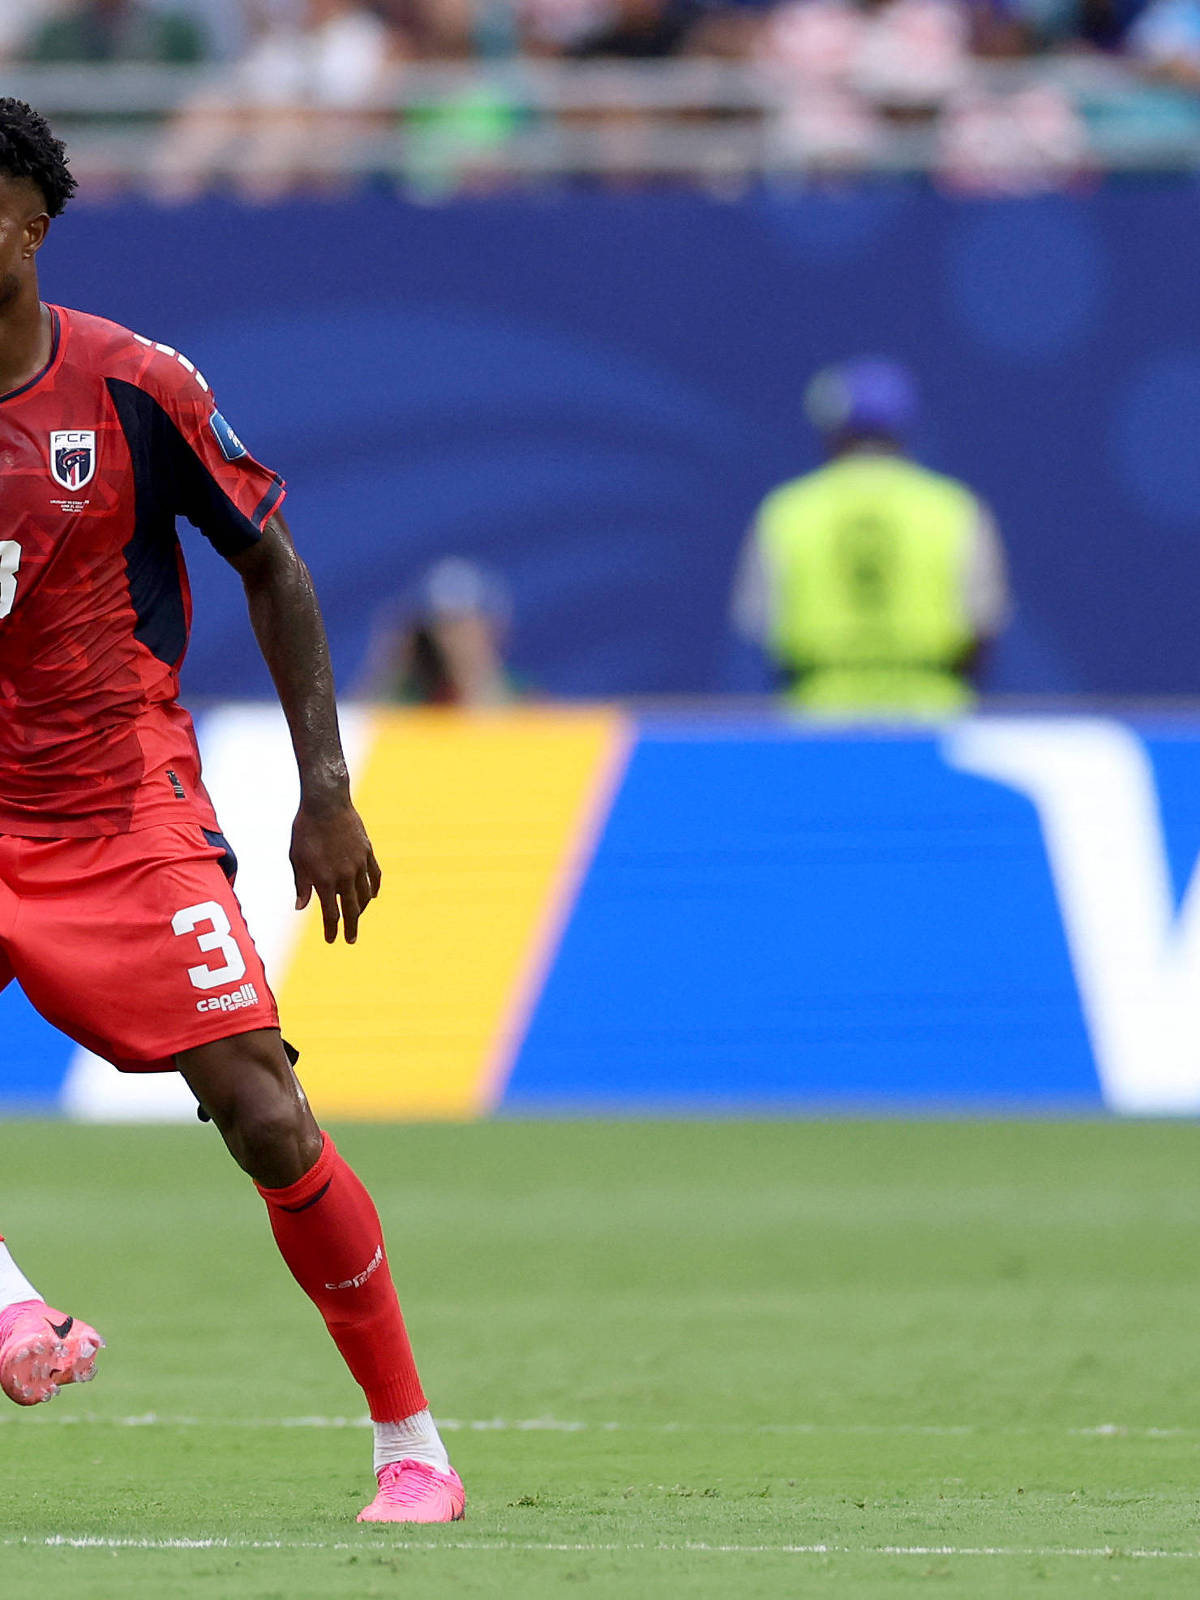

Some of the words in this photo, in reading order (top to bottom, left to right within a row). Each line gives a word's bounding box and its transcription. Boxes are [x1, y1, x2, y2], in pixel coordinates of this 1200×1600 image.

[54, 433, 92, 443] FCF
[171, 900, 247, 990] 3
[196, 983, 257, 1012] capelli
